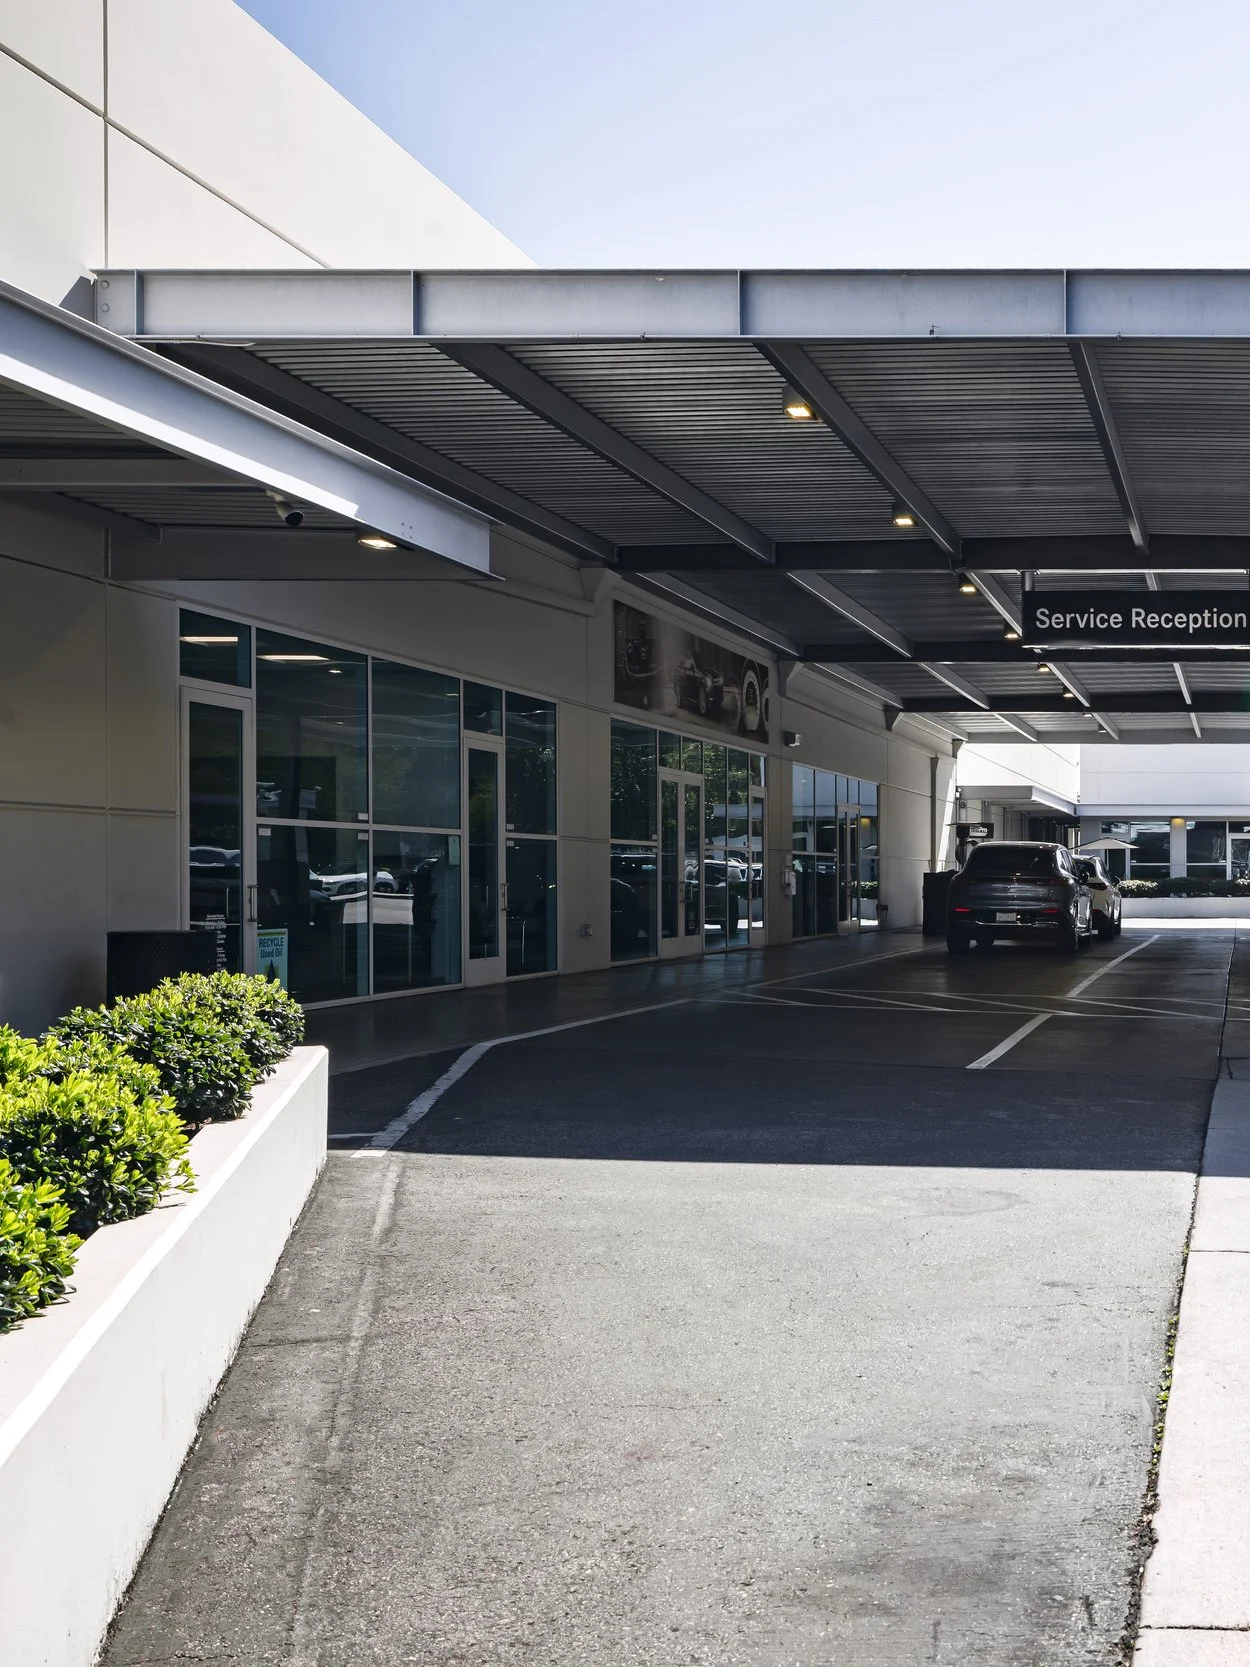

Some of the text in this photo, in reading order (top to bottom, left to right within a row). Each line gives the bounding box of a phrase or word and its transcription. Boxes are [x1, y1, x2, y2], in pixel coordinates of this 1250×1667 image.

[1035, 608, 1247, 633] Service Reception
[259, 937, 284, 947] RECYCLE
[260, 947, 283, 958] Used Oil
